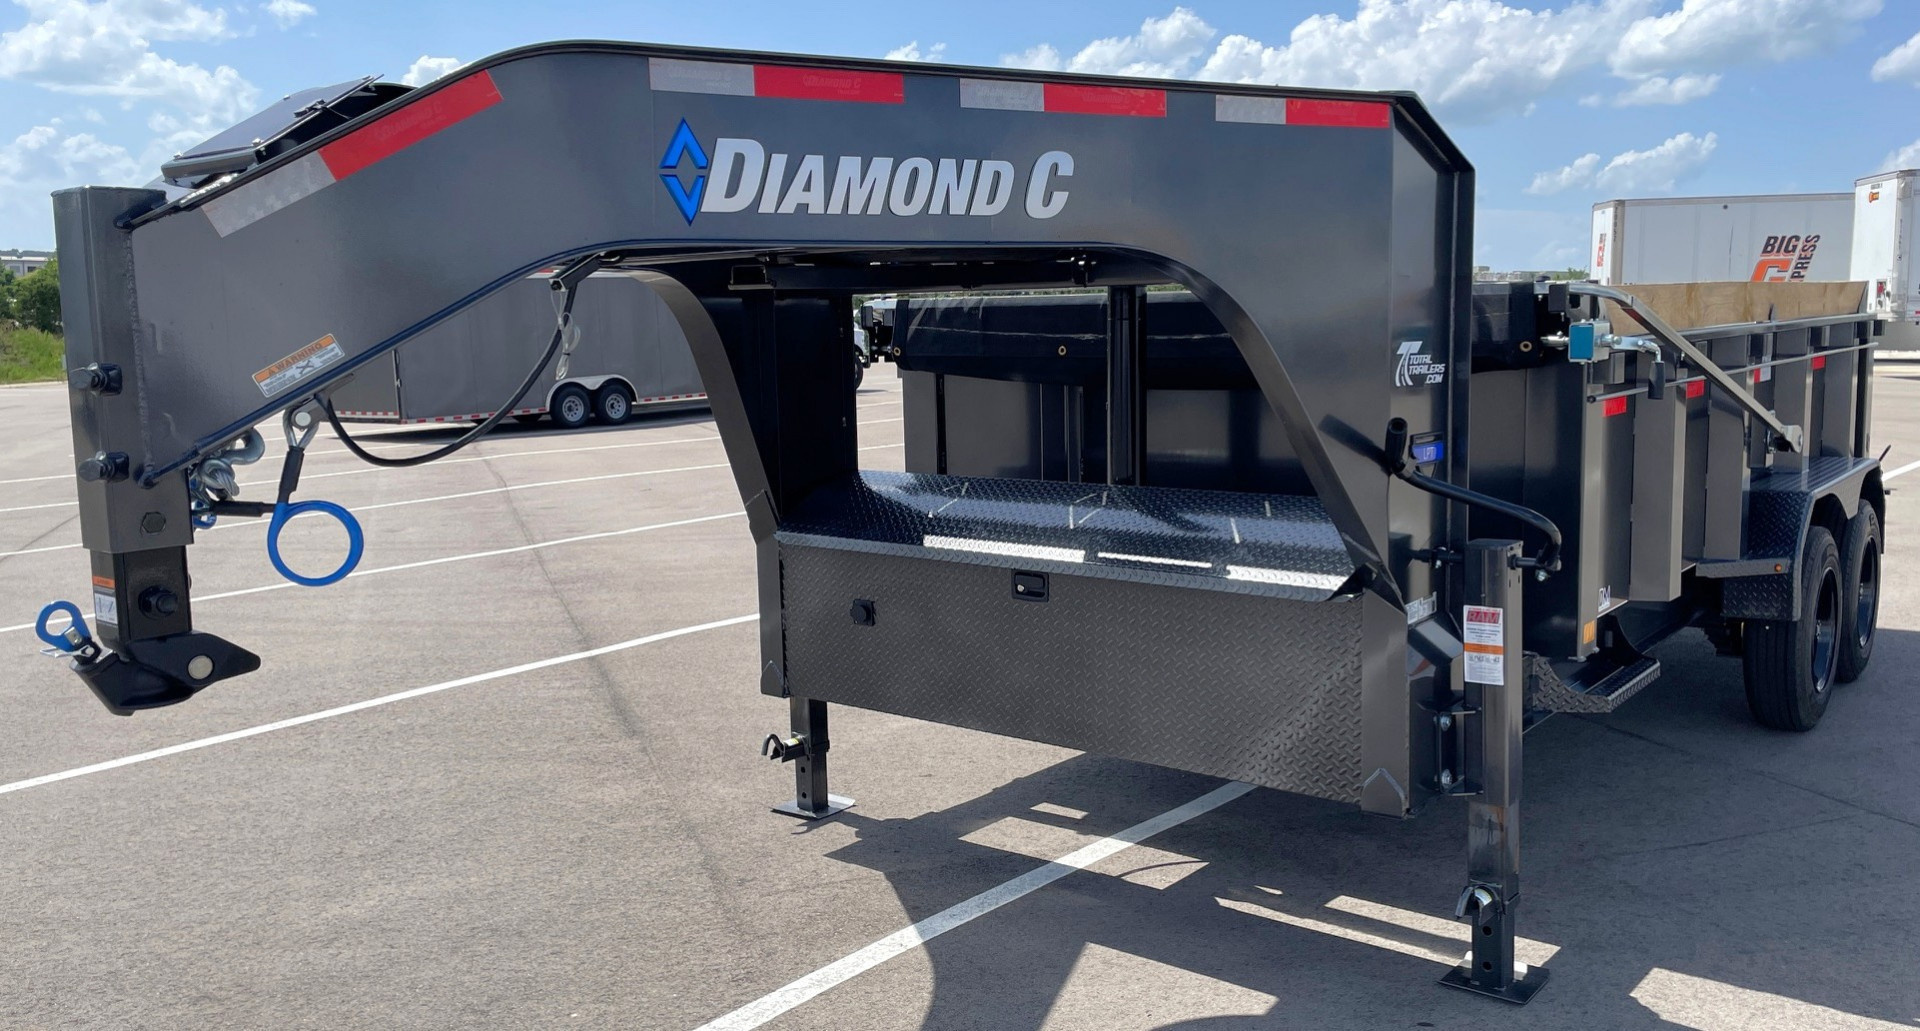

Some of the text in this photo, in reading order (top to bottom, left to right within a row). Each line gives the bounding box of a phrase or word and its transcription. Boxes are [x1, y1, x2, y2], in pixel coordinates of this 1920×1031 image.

[700, 137, 1075, 219] DIAMOND C
[1761, 235, 1801, 255] BIG
[275, 343, 322, 371] WARNING
[1409, 354, 1433, 364] TOTAL
[1409, 363, 1446, 375] TRAILERS
[1425, 374, 1443, 384] .COM
[1467, 610, 1499, 624] RAM
